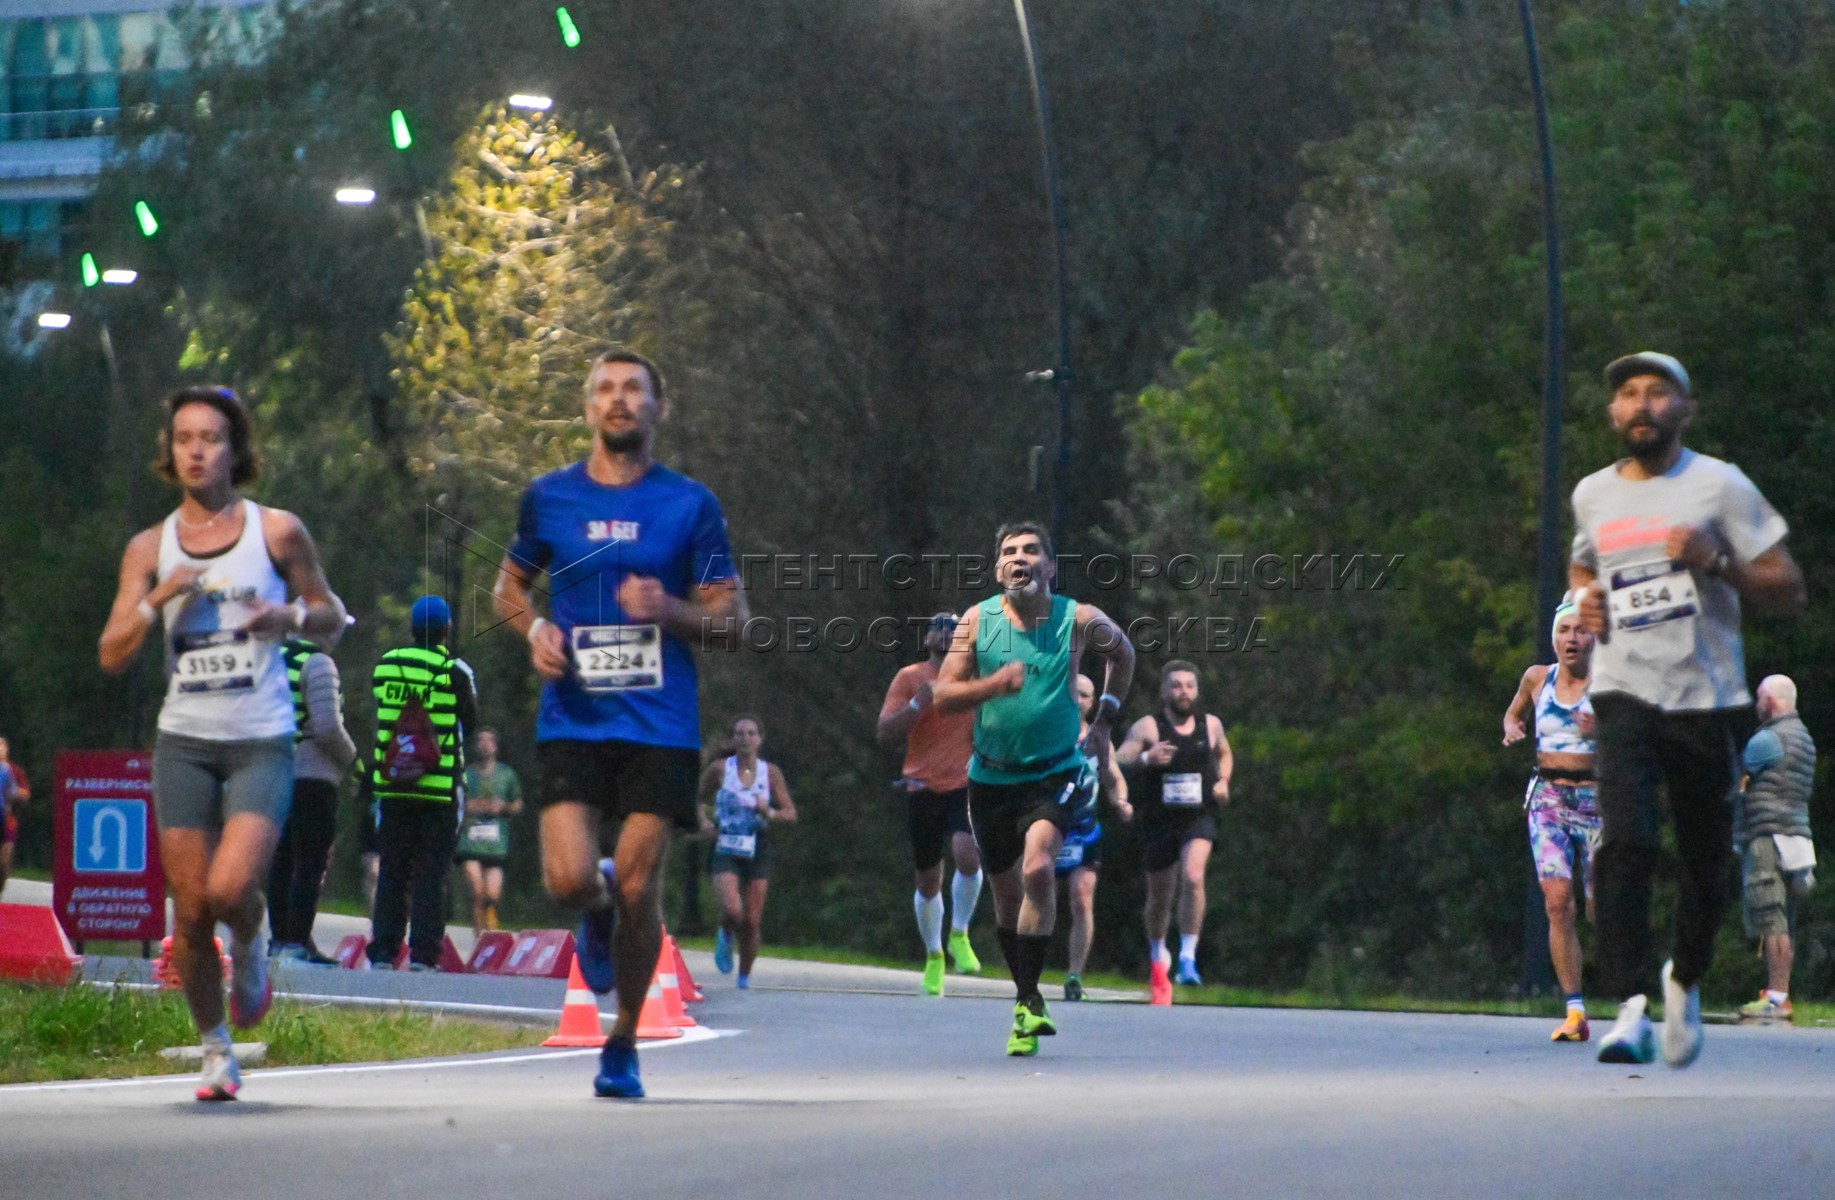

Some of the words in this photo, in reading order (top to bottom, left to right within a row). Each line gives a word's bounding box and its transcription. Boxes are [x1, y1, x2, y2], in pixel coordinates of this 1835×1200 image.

[1630, 586, 1673, 608] 854
[188, 654, 237, 675] 3159
[589, 653, 645, 670] 2224
